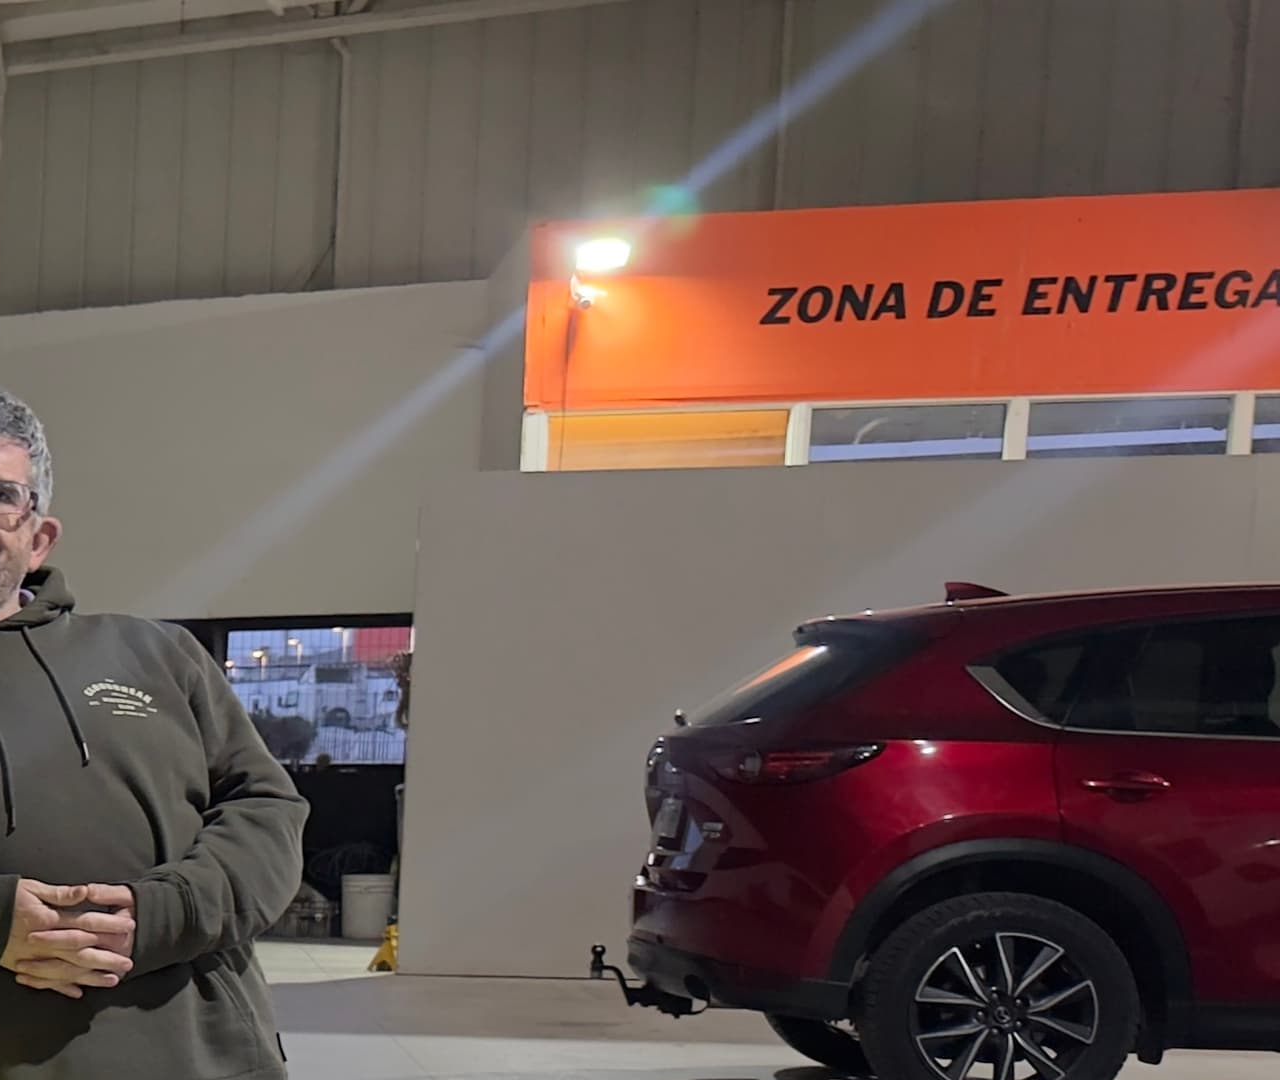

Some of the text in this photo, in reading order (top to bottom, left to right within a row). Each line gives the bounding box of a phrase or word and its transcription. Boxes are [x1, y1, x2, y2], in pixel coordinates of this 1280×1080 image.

[759, 269, 1280, 325] ZONA DE ENTREGA
